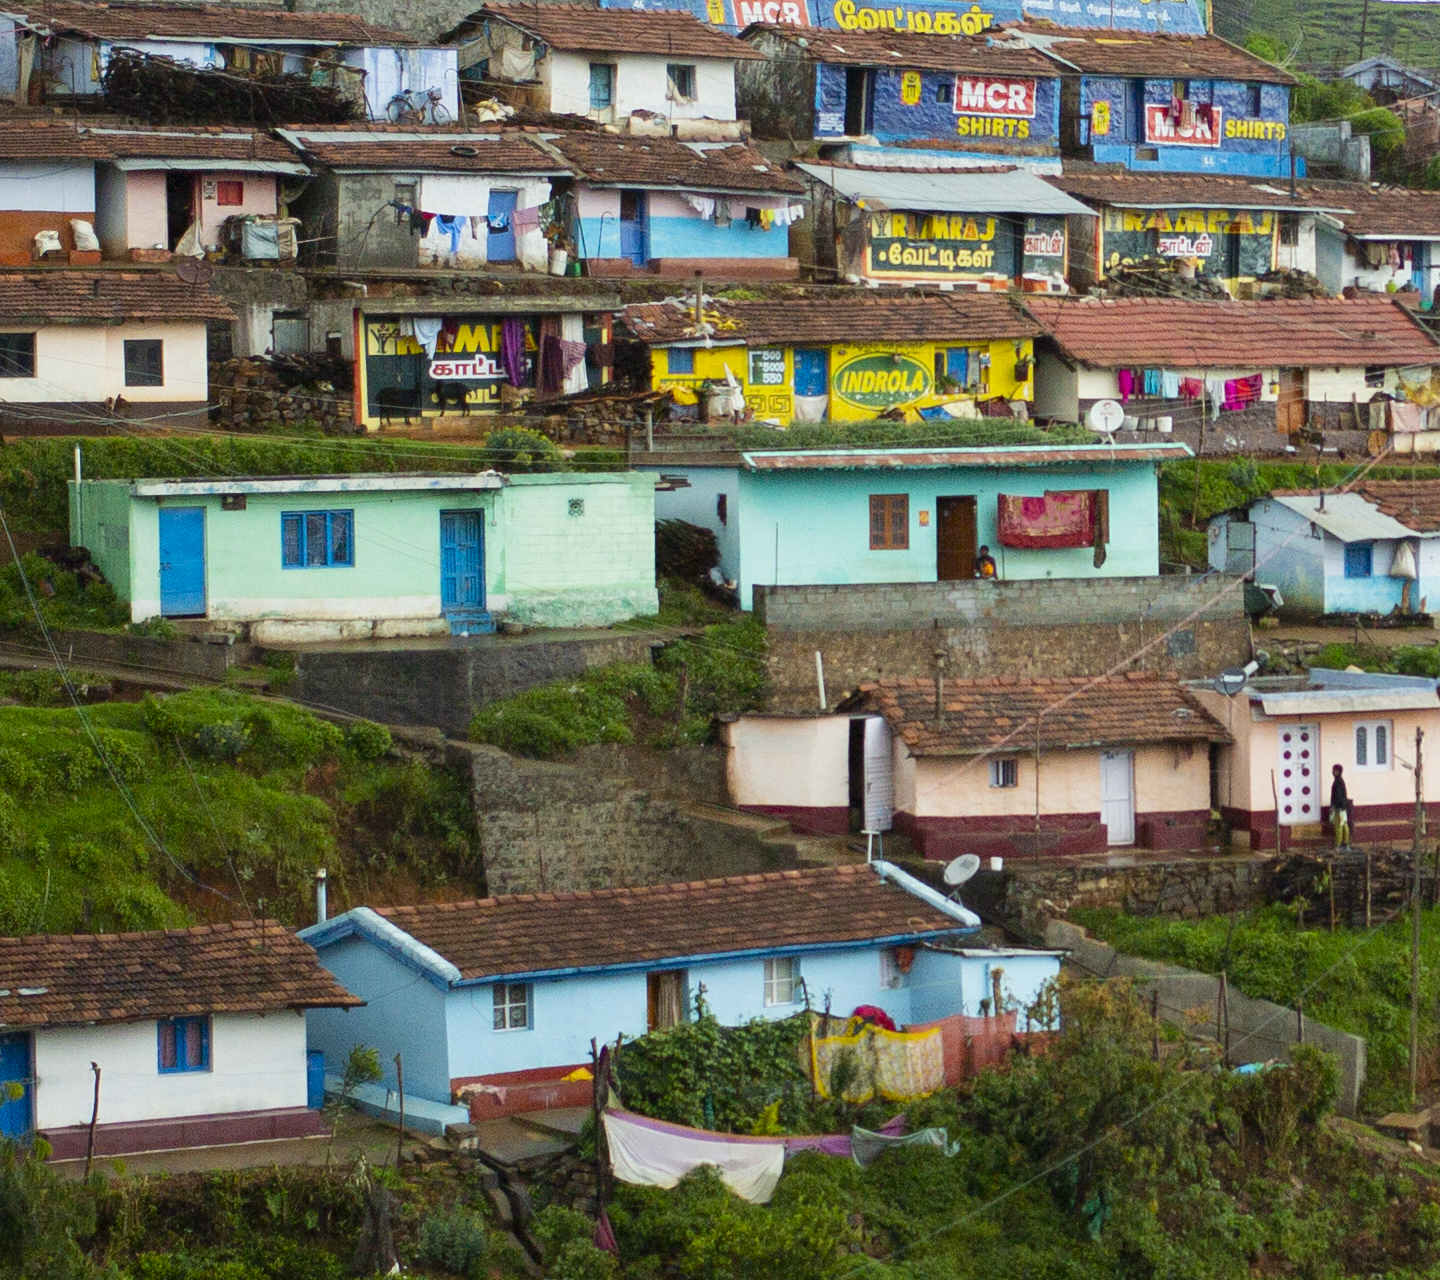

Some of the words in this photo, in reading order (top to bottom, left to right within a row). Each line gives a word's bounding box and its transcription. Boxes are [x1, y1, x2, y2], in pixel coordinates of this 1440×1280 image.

[740, 0, 803, 27] MCR
[961, 78, 1027, 111] MCR
[956, 116, 1031, 139] SHIRTS
[1224, 118, 1286, 142] SHIRTS
[888, 242, 995, 271] வேட்டிகள்
[840, 370, 925, 393] INDROLA
